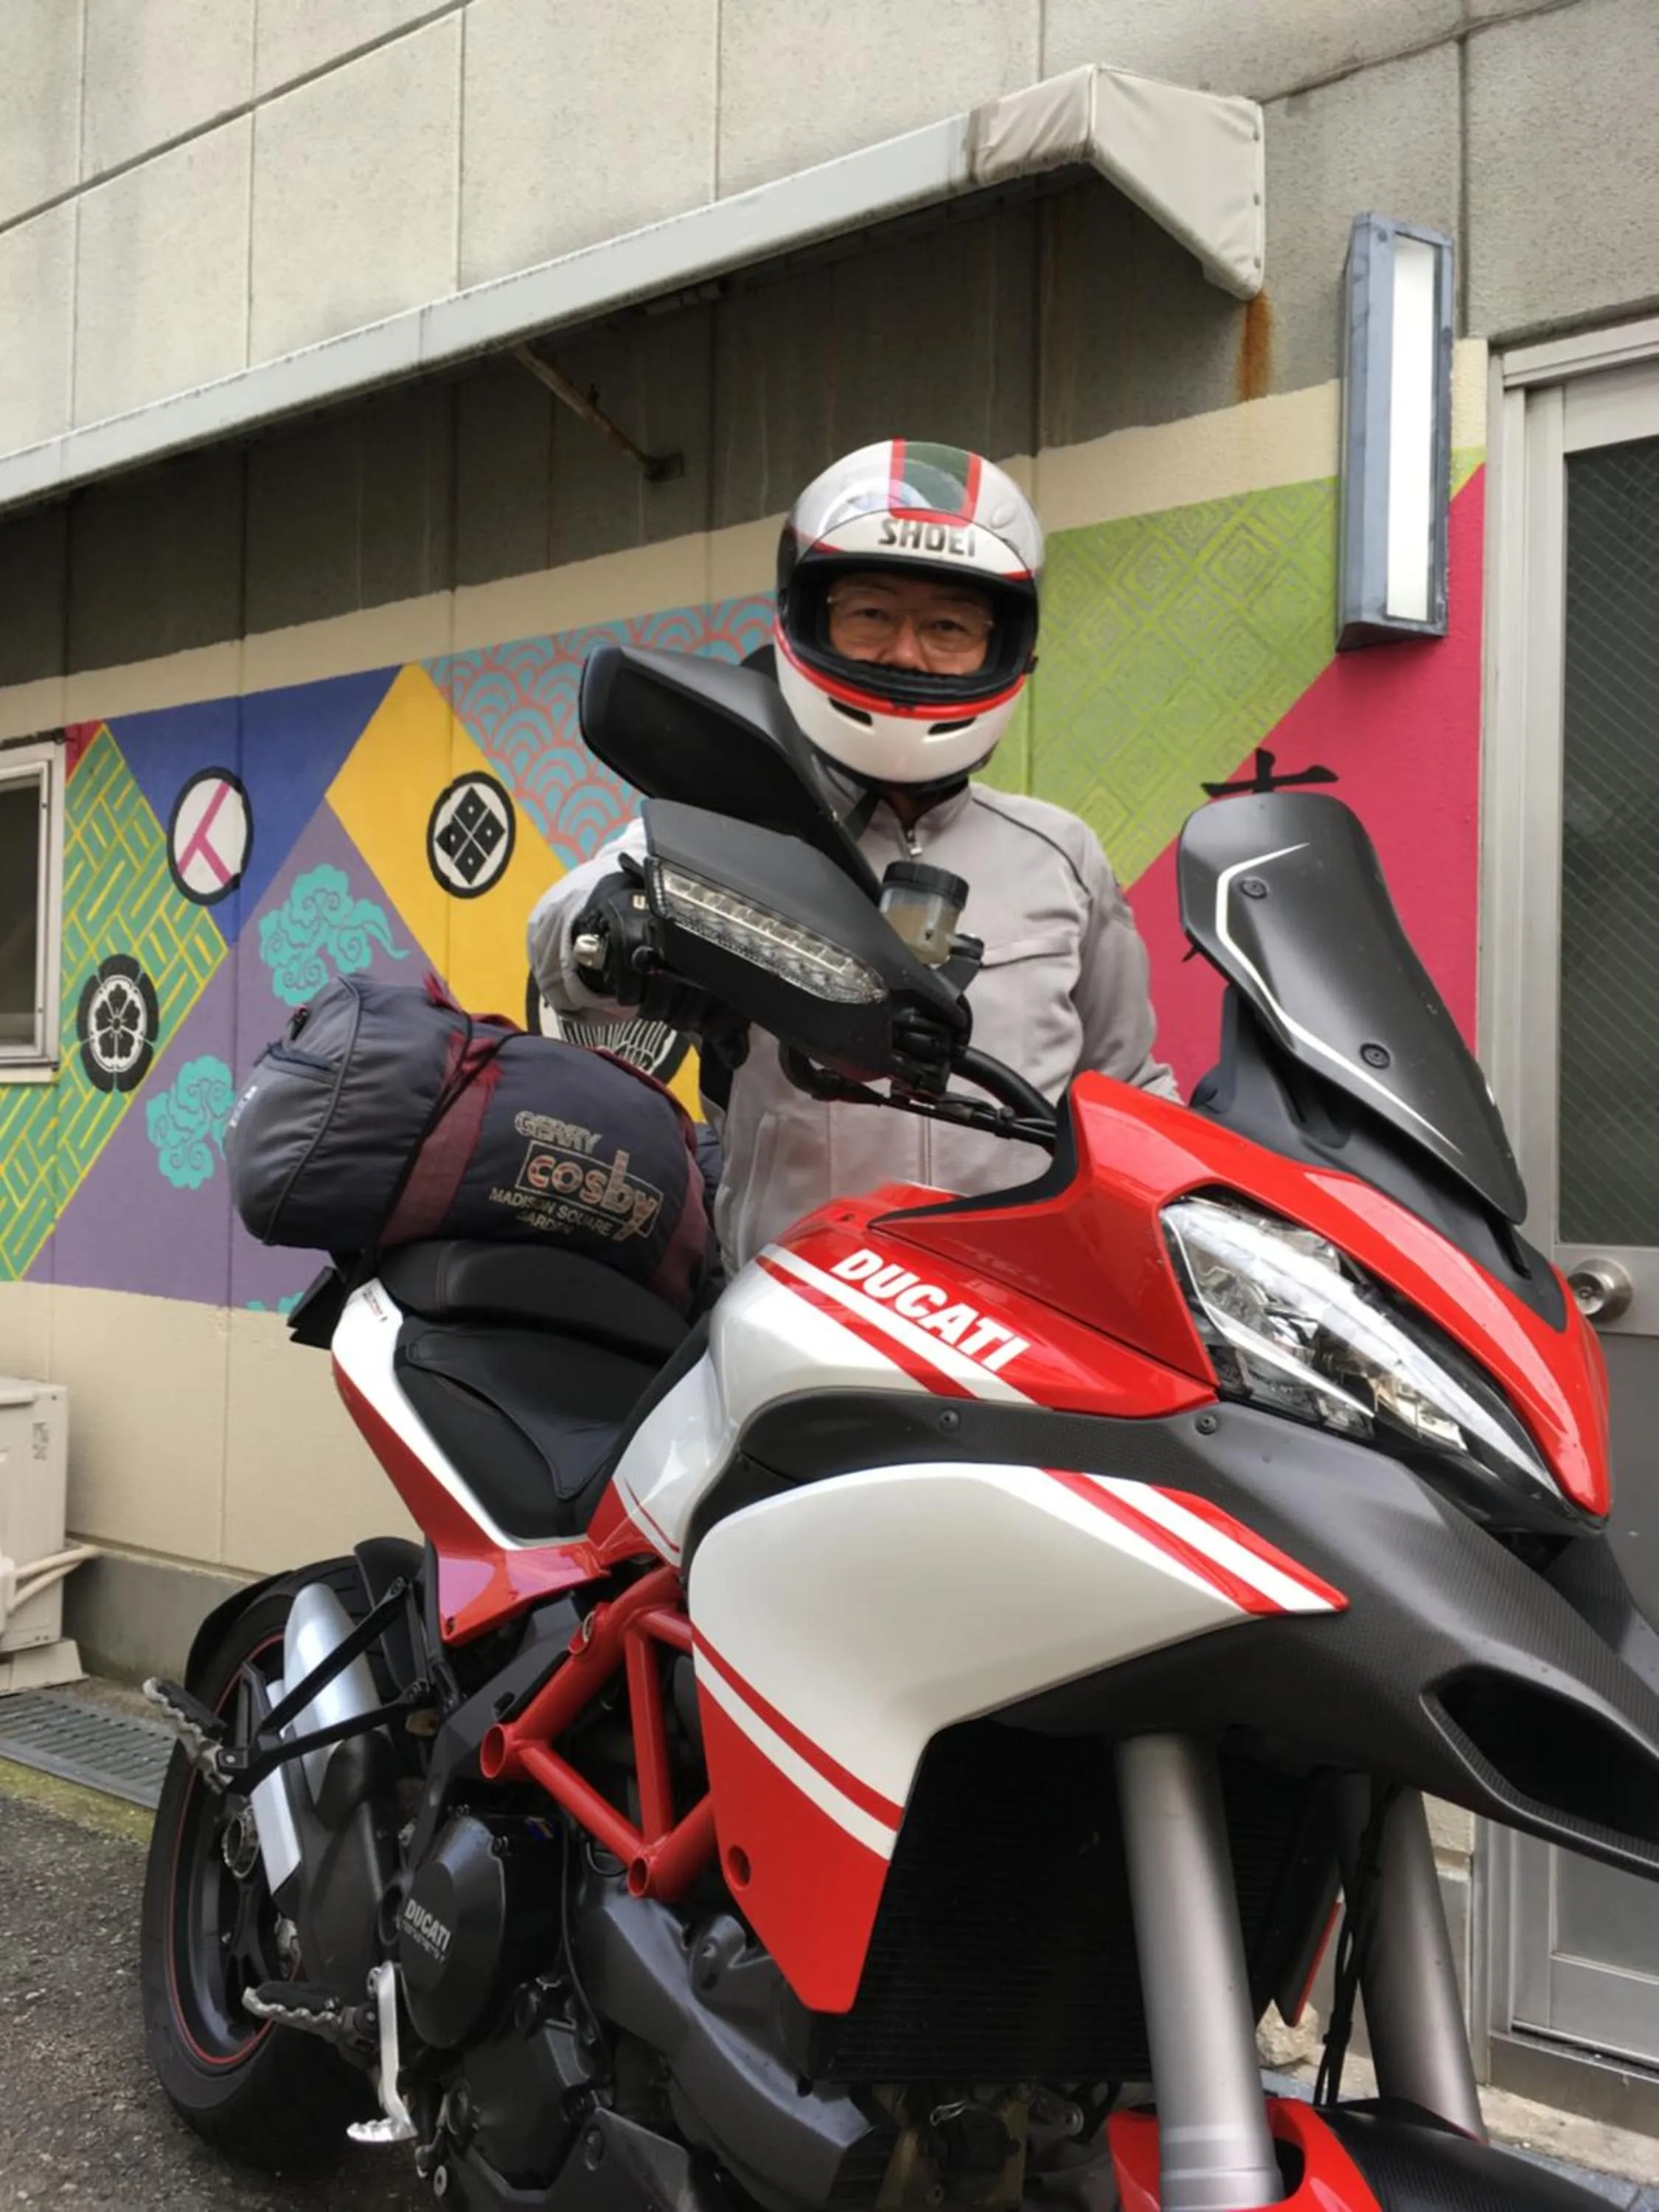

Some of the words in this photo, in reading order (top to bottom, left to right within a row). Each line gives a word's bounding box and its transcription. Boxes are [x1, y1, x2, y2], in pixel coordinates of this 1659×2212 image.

[877, 518, 975, 557] SHOEI
[526, 1149, 658, 1242] cosby
[556, 1204, 613, 1237] SQUARE
[830, 1248, 1031, 1371] DUCATI
[404, 1898, 451, 1952] DUCATI
